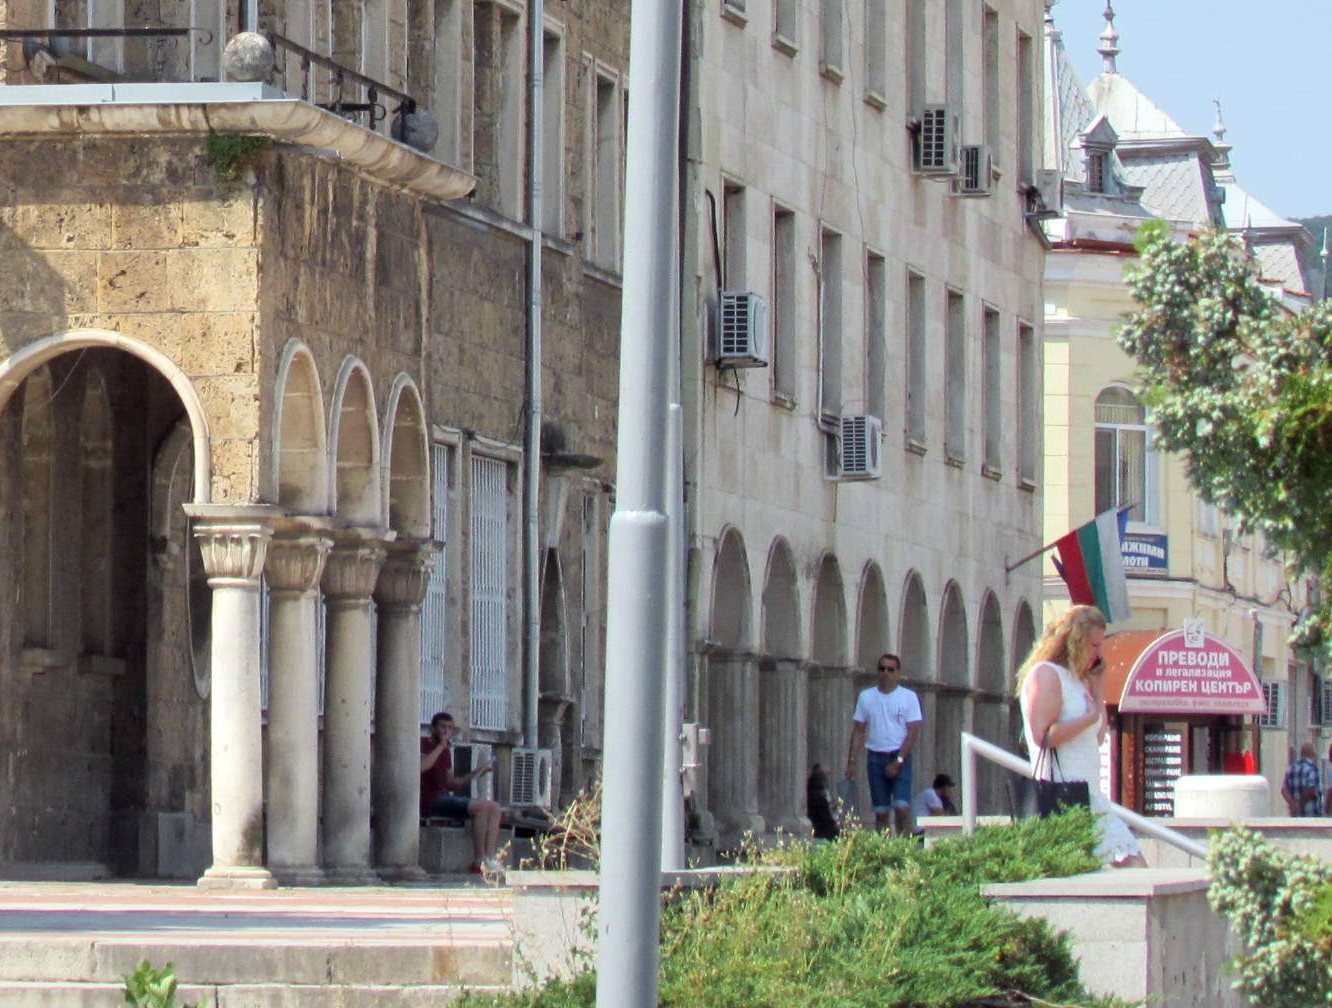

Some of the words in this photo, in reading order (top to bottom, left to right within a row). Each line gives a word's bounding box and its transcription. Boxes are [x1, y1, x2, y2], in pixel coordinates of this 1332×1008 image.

[1158, 650, 1230, 667] ПРЕВОДИ
[1156, 668, 1163, 676] и
[1165, 668, 1232, 679] легализация
[1135, 680, 1197, 693] КОПИРЕН
[1201, 681, 1252, 695] ЦЕНТЪР
